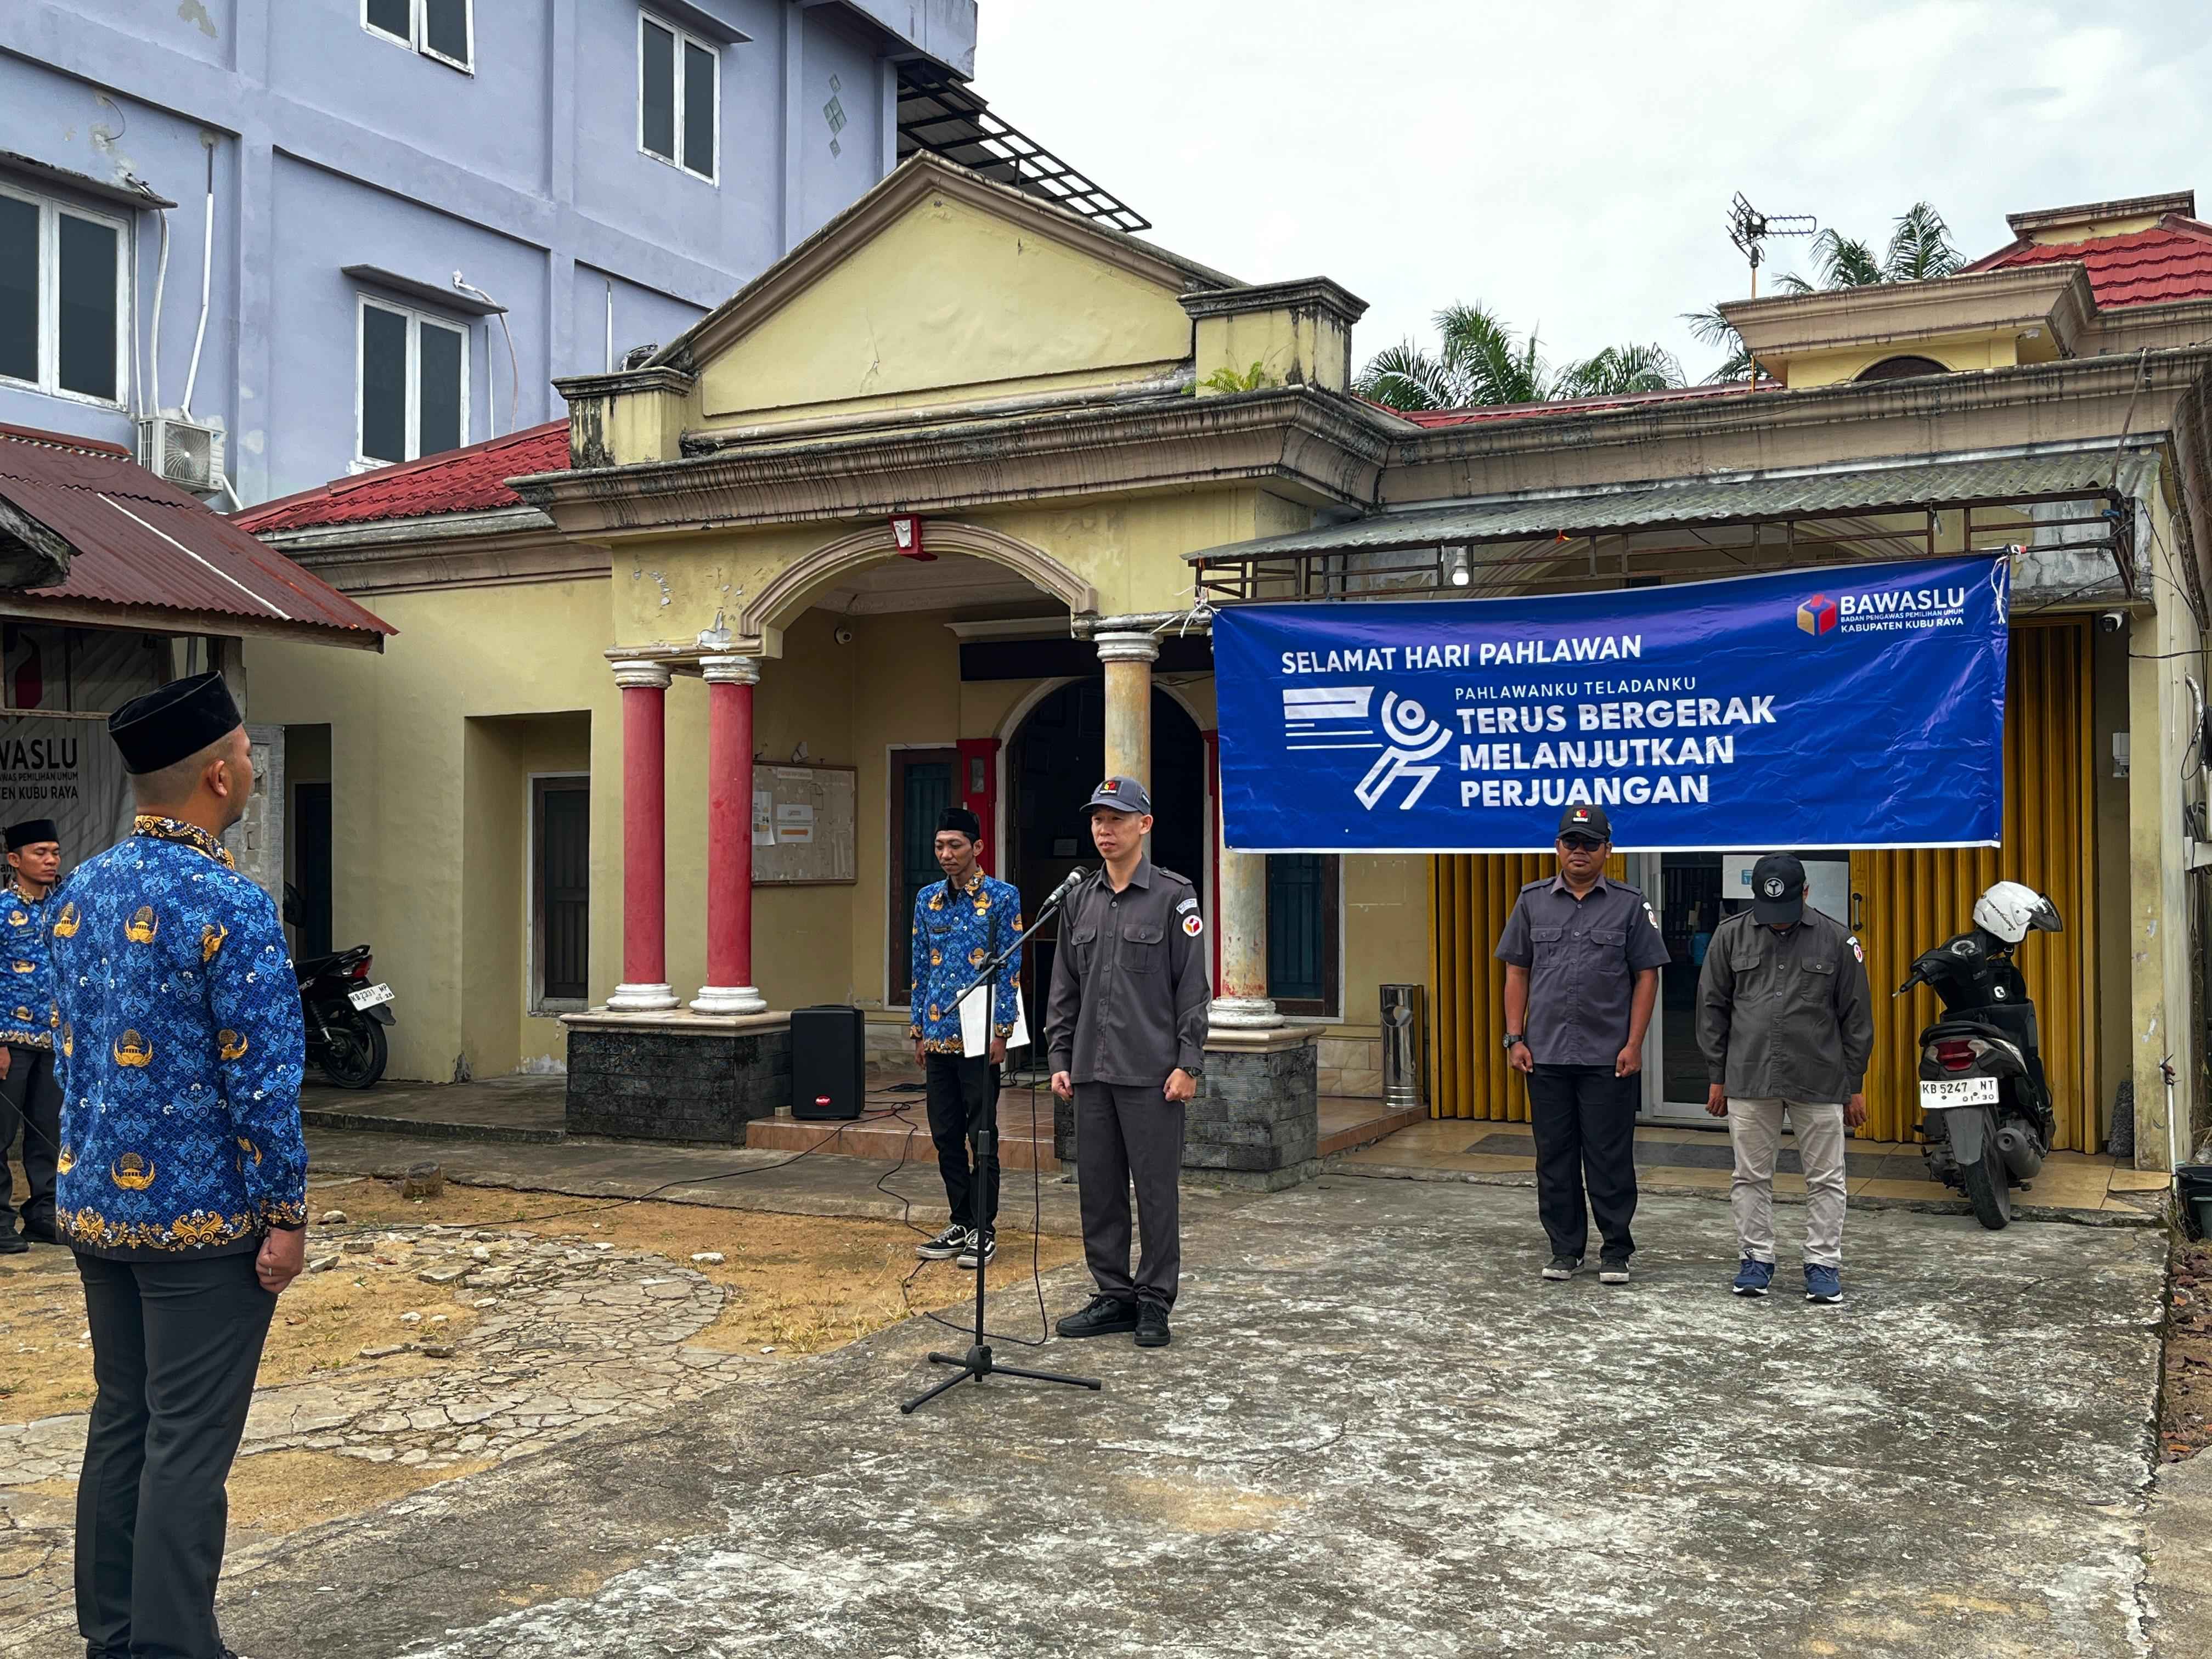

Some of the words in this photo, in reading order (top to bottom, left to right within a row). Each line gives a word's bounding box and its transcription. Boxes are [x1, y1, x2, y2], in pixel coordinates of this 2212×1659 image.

[1840, 587, 1965, 615] BAWASLU
[1841, 621, 1903, 633] KABUPATEN
[1905, 619, 1934, 629] KUBU
[1937, 617, 1963, 627] RAYA
[1866, 612, 1904, 620] PENGAWAS
[1905, 610, 1942, 618] PEMILIHAN
[1282, 648, 1396, 674] SELAMAT
[1406, 644, 1470, 669] HARI
[1480, 635, 1641, 665] PAHLAWAN
[1455, 682, 1577, 700] PAHLAWANKU
[1584, 677, 1695, 695] TELADANKU
[1457, 705, 1566, 734] TERUS
[1578, 695, 1776, 730] BERGERAK
[1460, 735, 1734, 770] MELANJUTKAN
[18, 772, 55, 781] PEMILIHAN
[57, 772, 78, 781] UMUM
[19, 786, 47, 799] KUBU
[50, 786, 78, 799] RAYA
[1461, 775, 1708, 807] PERJUANGAN
[1922, 1084, 1937, 1094] KB
[1940, 1082, 1967, 1093] 5247
[1980, 1080, 1994, 1090] NT
